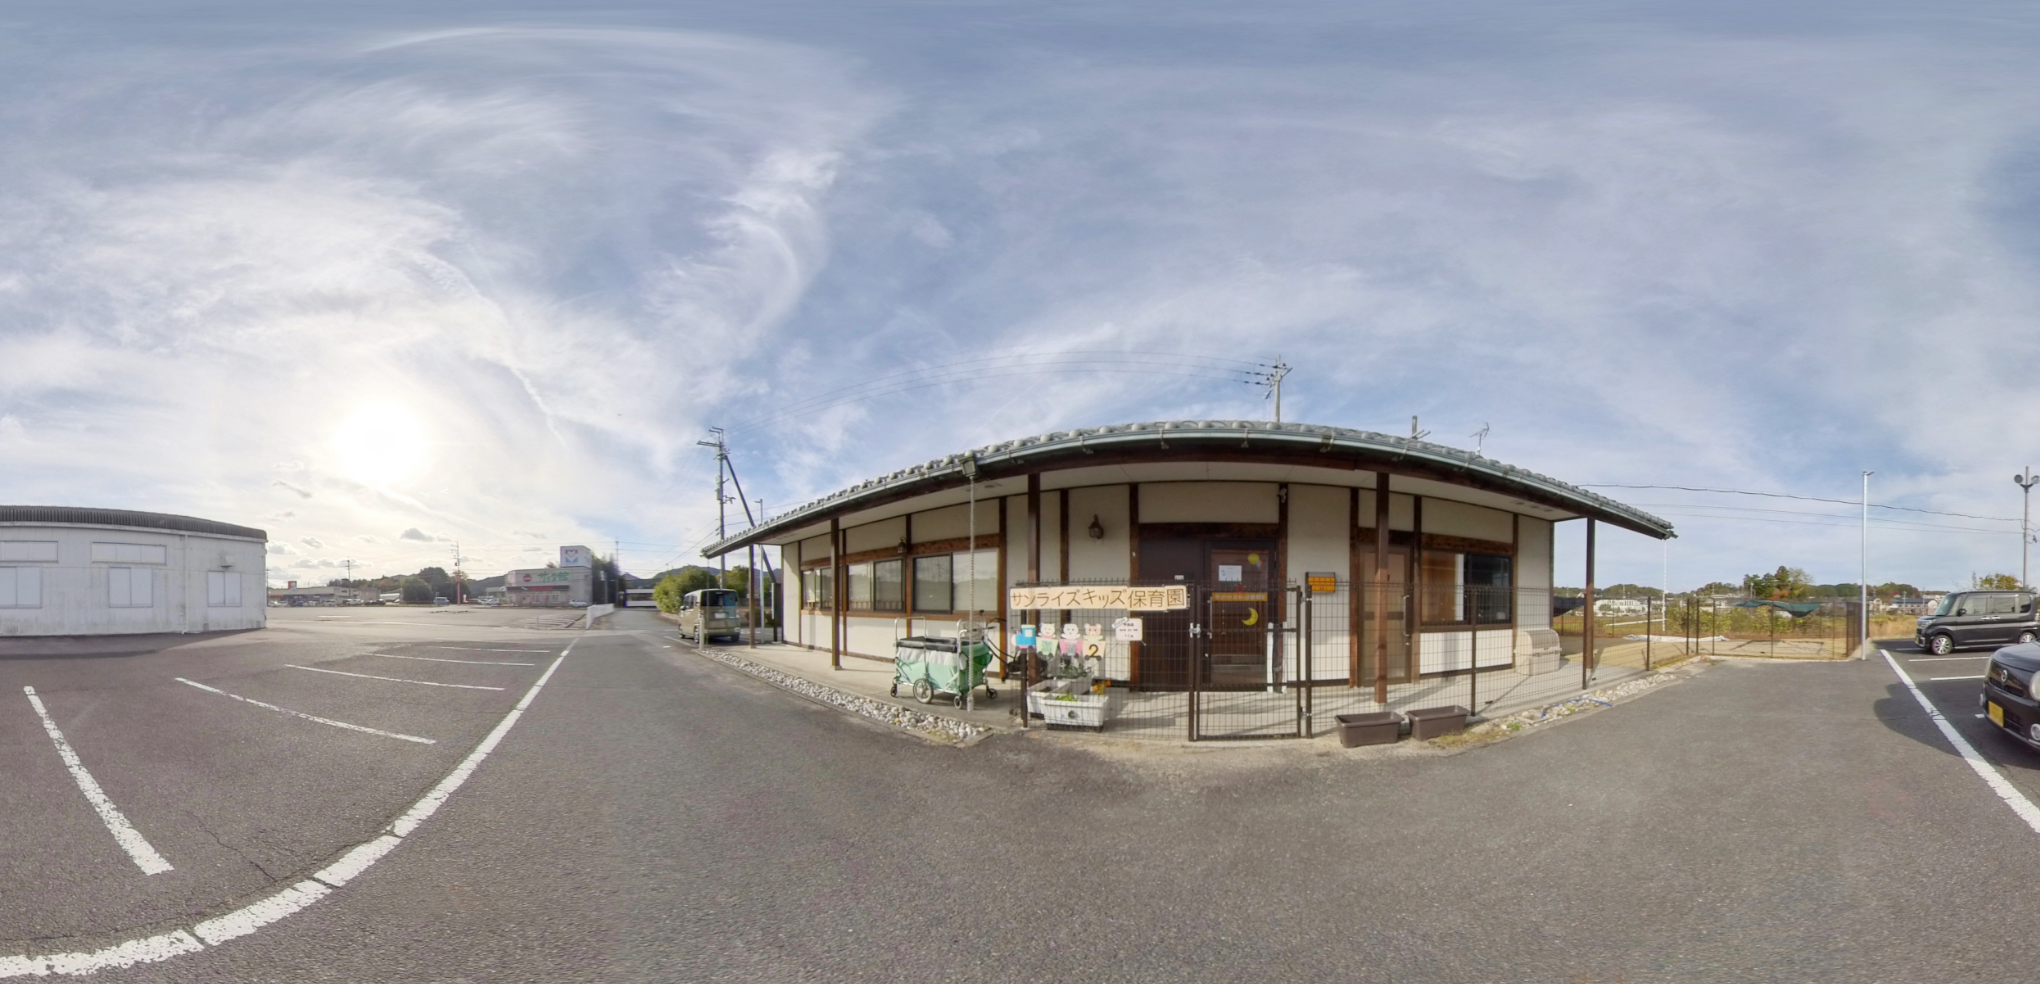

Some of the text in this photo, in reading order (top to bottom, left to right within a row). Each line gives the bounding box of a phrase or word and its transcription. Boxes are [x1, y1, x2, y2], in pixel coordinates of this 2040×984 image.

[1011, 588, 1185, 608] サンライズキッズ保育園
